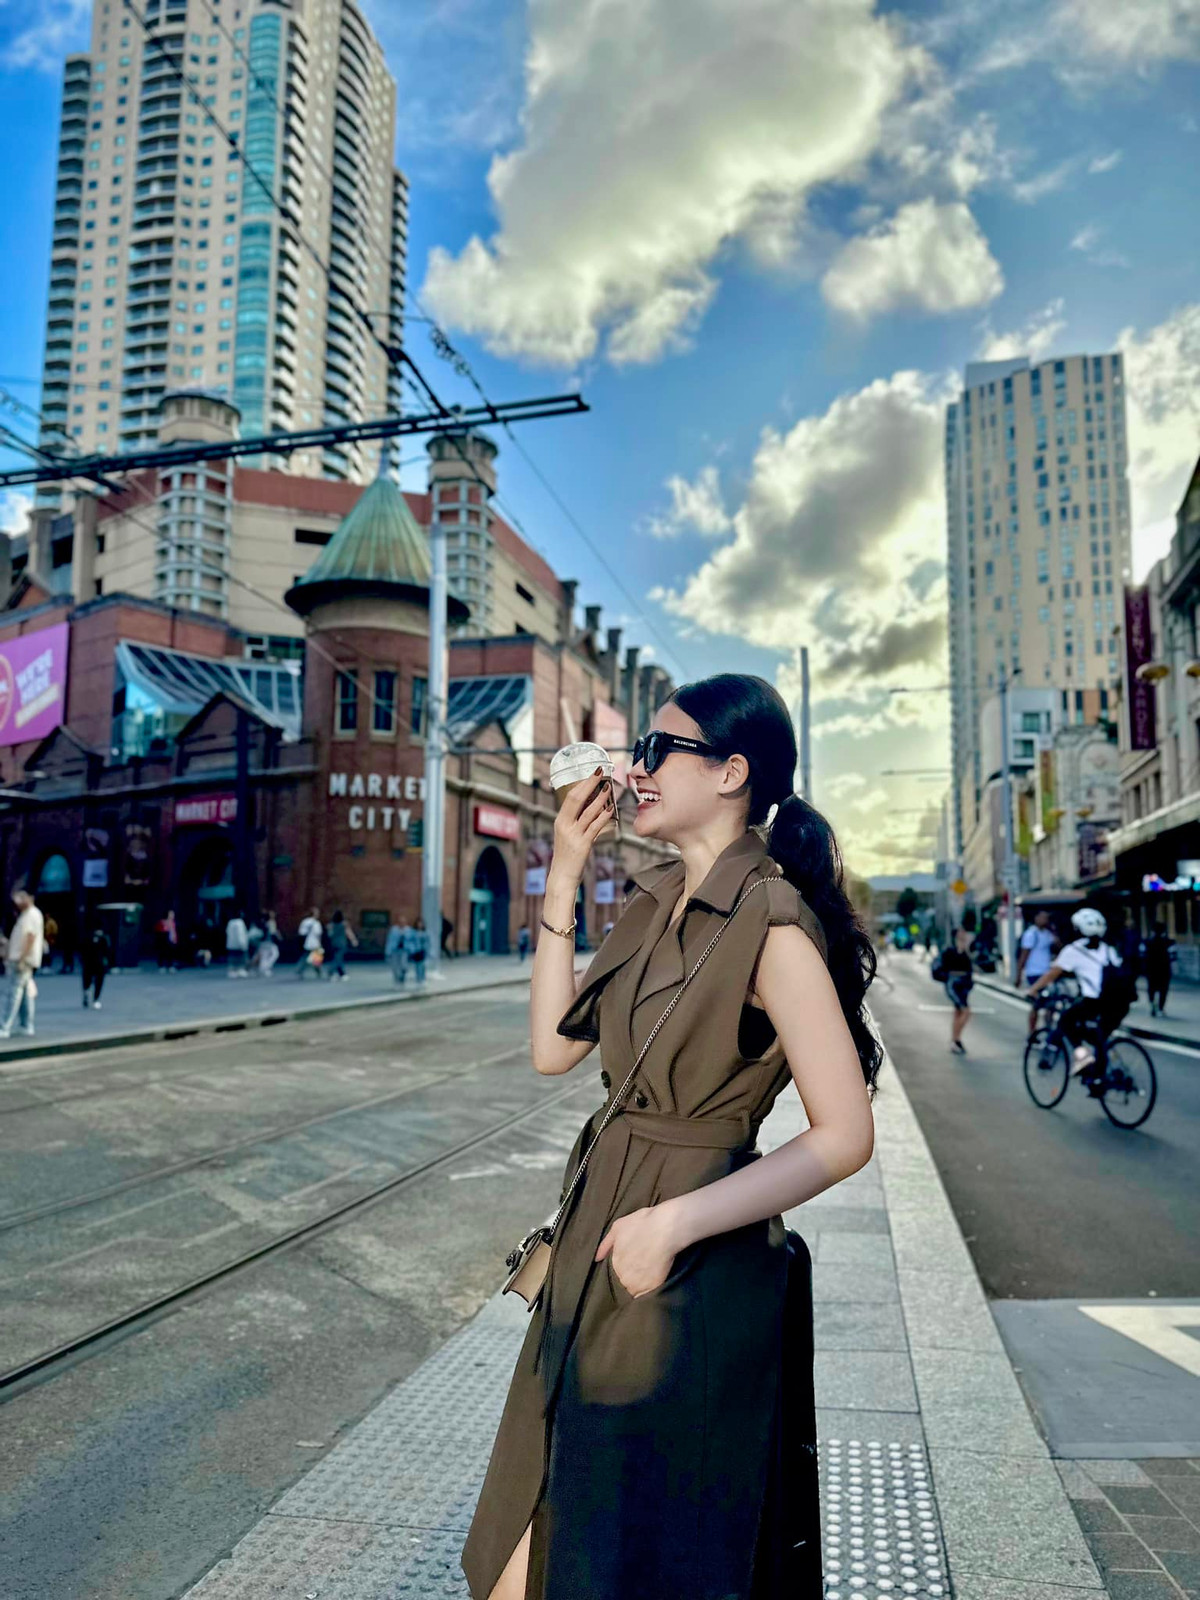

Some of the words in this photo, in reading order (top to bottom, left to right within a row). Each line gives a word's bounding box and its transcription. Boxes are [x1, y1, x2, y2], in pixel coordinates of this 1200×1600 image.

[1133, 678, 1149, 748] ARDEN
[328, 773, 427, 801] MARKET
[348, 805, 412, 832] CITY
